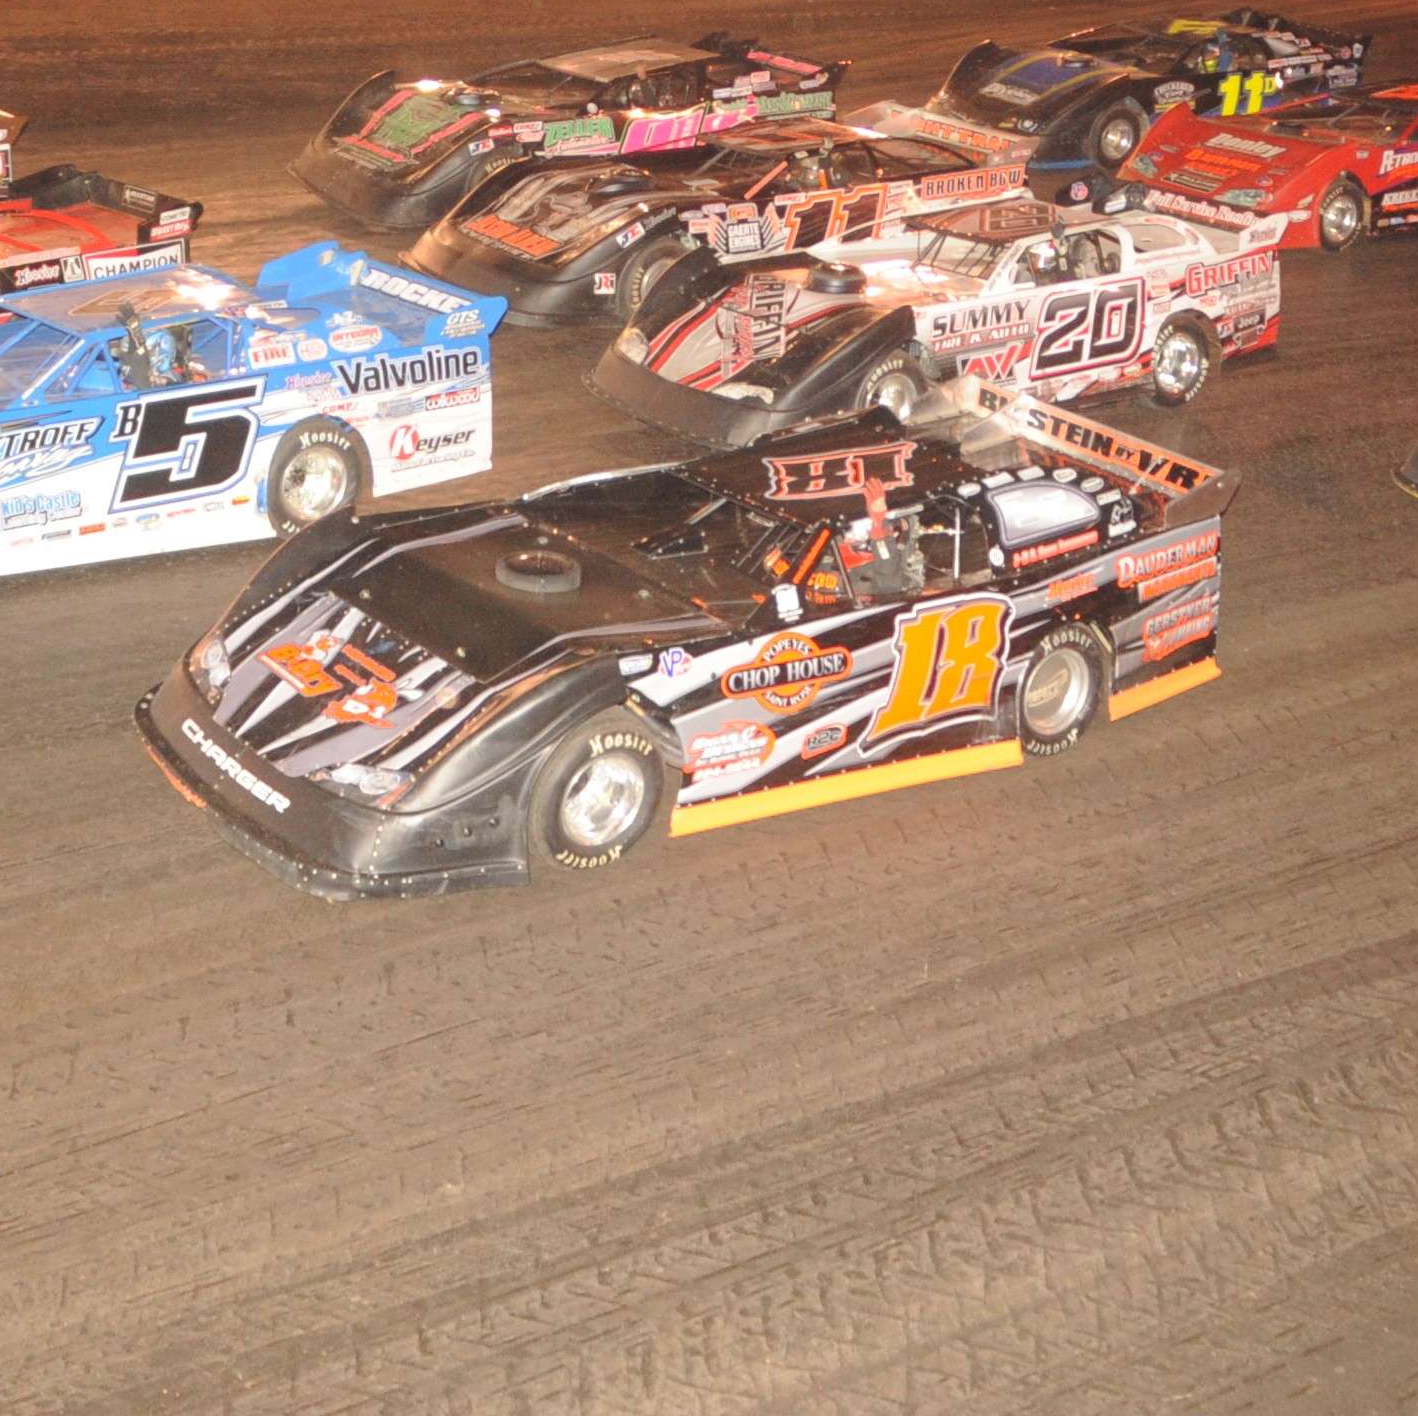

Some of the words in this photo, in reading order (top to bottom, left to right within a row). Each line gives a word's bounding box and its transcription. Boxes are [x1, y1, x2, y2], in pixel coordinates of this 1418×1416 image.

[93, 252, 180, 280] CHAMPION
[1186, 253, 1273, 297] GRIFFIN
[1036, 282, 1141, 372] 20
[337, 348, 479, 396] Valvoline
[119, 384, 258, 504] 5
[299, 431, 352, 451] Hoosier
[390, 424, 476, 460] Keyser
[763, 638, 813, 663] POPEYES
[865, 598, 1011, 742] 18
[729, 667, 780, 692] CHOP
[786, 652, 845, 681] HOUSE
[180, 717, 291, 814] CHARGER
[588, 732, 653, 759] Hoosier
